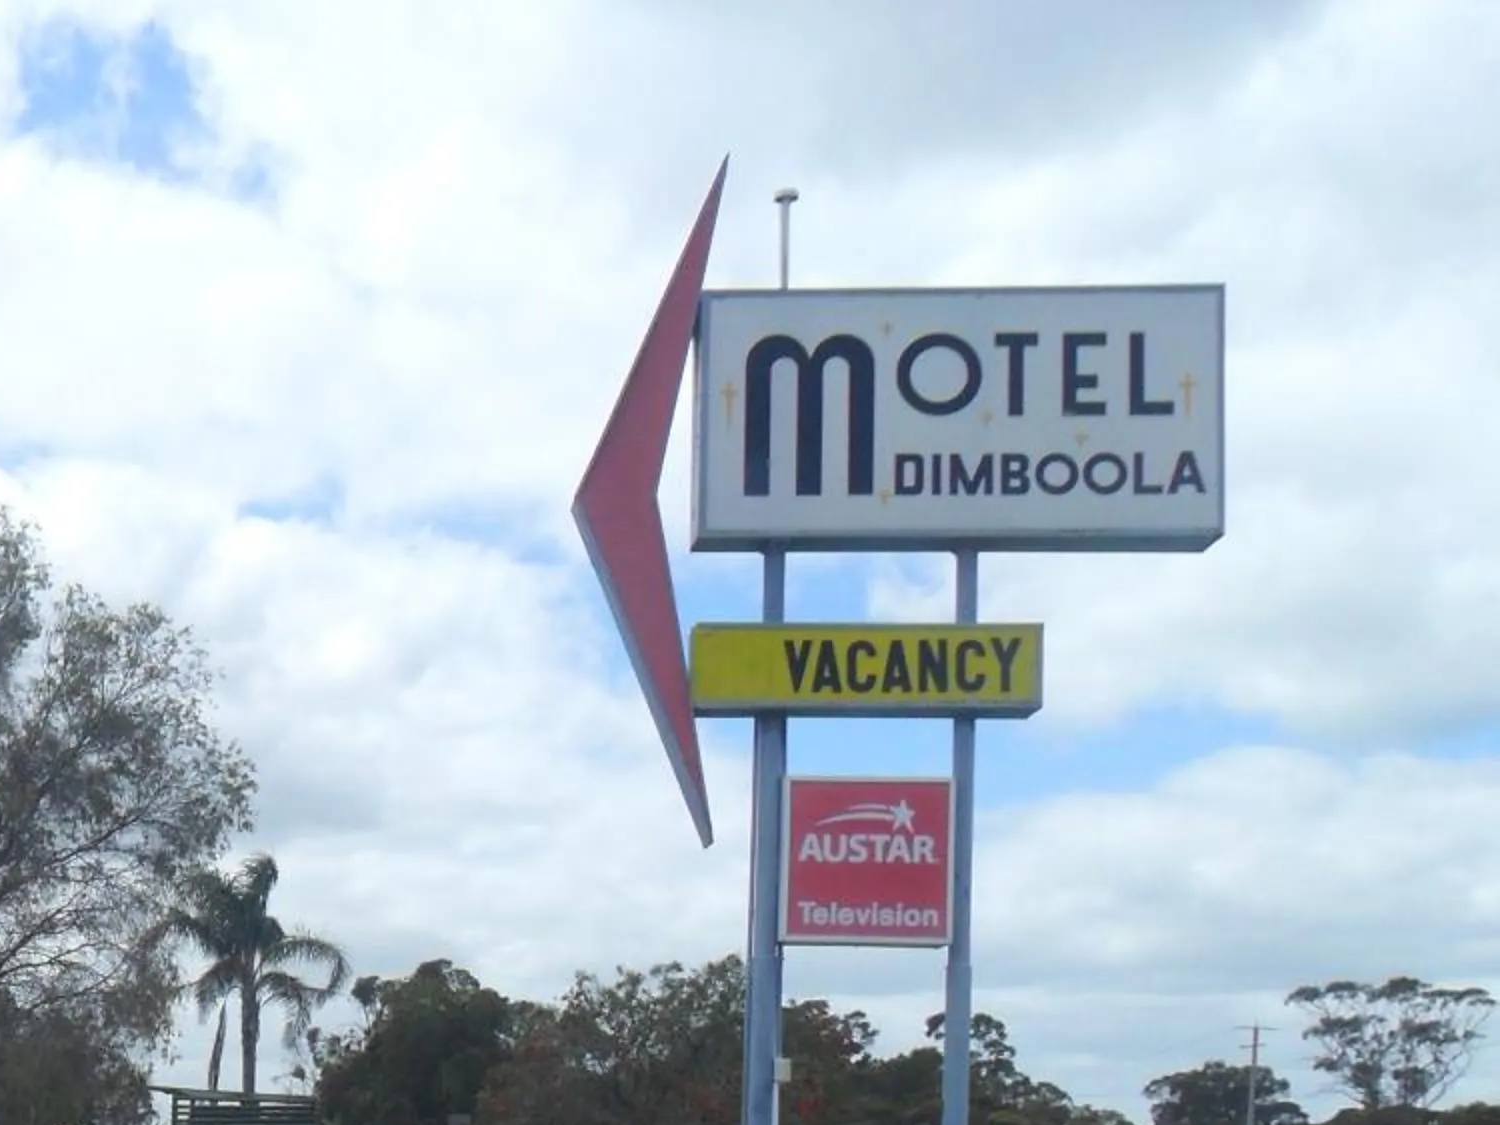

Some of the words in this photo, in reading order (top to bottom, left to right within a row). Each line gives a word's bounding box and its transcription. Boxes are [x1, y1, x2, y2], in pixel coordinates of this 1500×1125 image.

[743, 332, 1175, 496] MOTEL
[894, 451, 1206, 495] DIMBOOLA
[784, 638, 1022, 694] VACANCY
[799, 833, 935, 863] AUSTAR
[798, 901, 939, 927] Television
